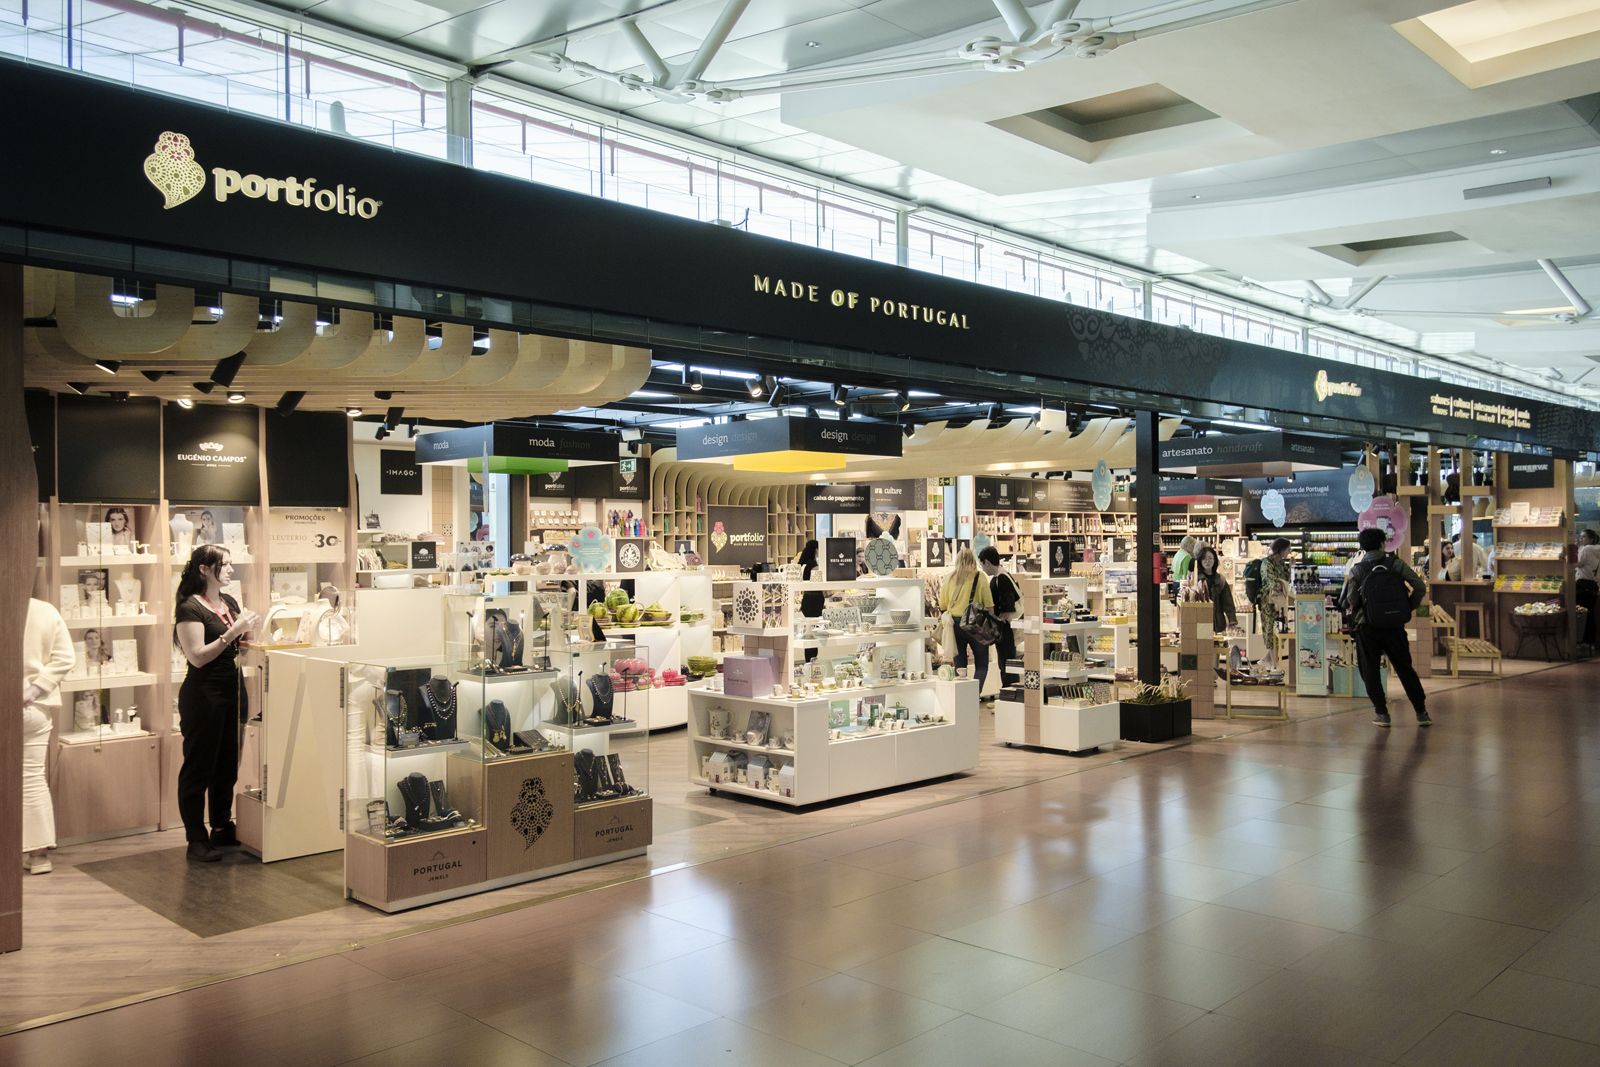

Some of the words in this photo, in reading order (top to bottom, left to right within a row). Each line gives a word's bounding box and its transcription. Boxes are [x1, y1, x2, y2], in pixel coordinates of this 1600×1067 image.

[212, 167, 379, 219] portfolio
[754, 274, 819, 302] MADE
[831, 289, 859, 309] OF
[870, 297, 970, 330] PORTUGAL
[702, 434, 729, 447] design
[820, 428, 848, 443] design
[433, 441, 449, 450] moda
[528, 438, 555, 448] moda
[177, 453, 211, 462] EUGÉNIO
[212, 455, 245, 463] CAMPOS
[1162, 446, 1213, 458] artesanato
[884, 486, 902, 495] culture
[1306, 485, 1329, 493] Portugal
[729, 532, 765, 544] portfolio
[595, 824, 634, 838] PORTUGAL
[413, 860, 462, 876] PORTUGAL
[427, 873, 449, 882] JEWELS
